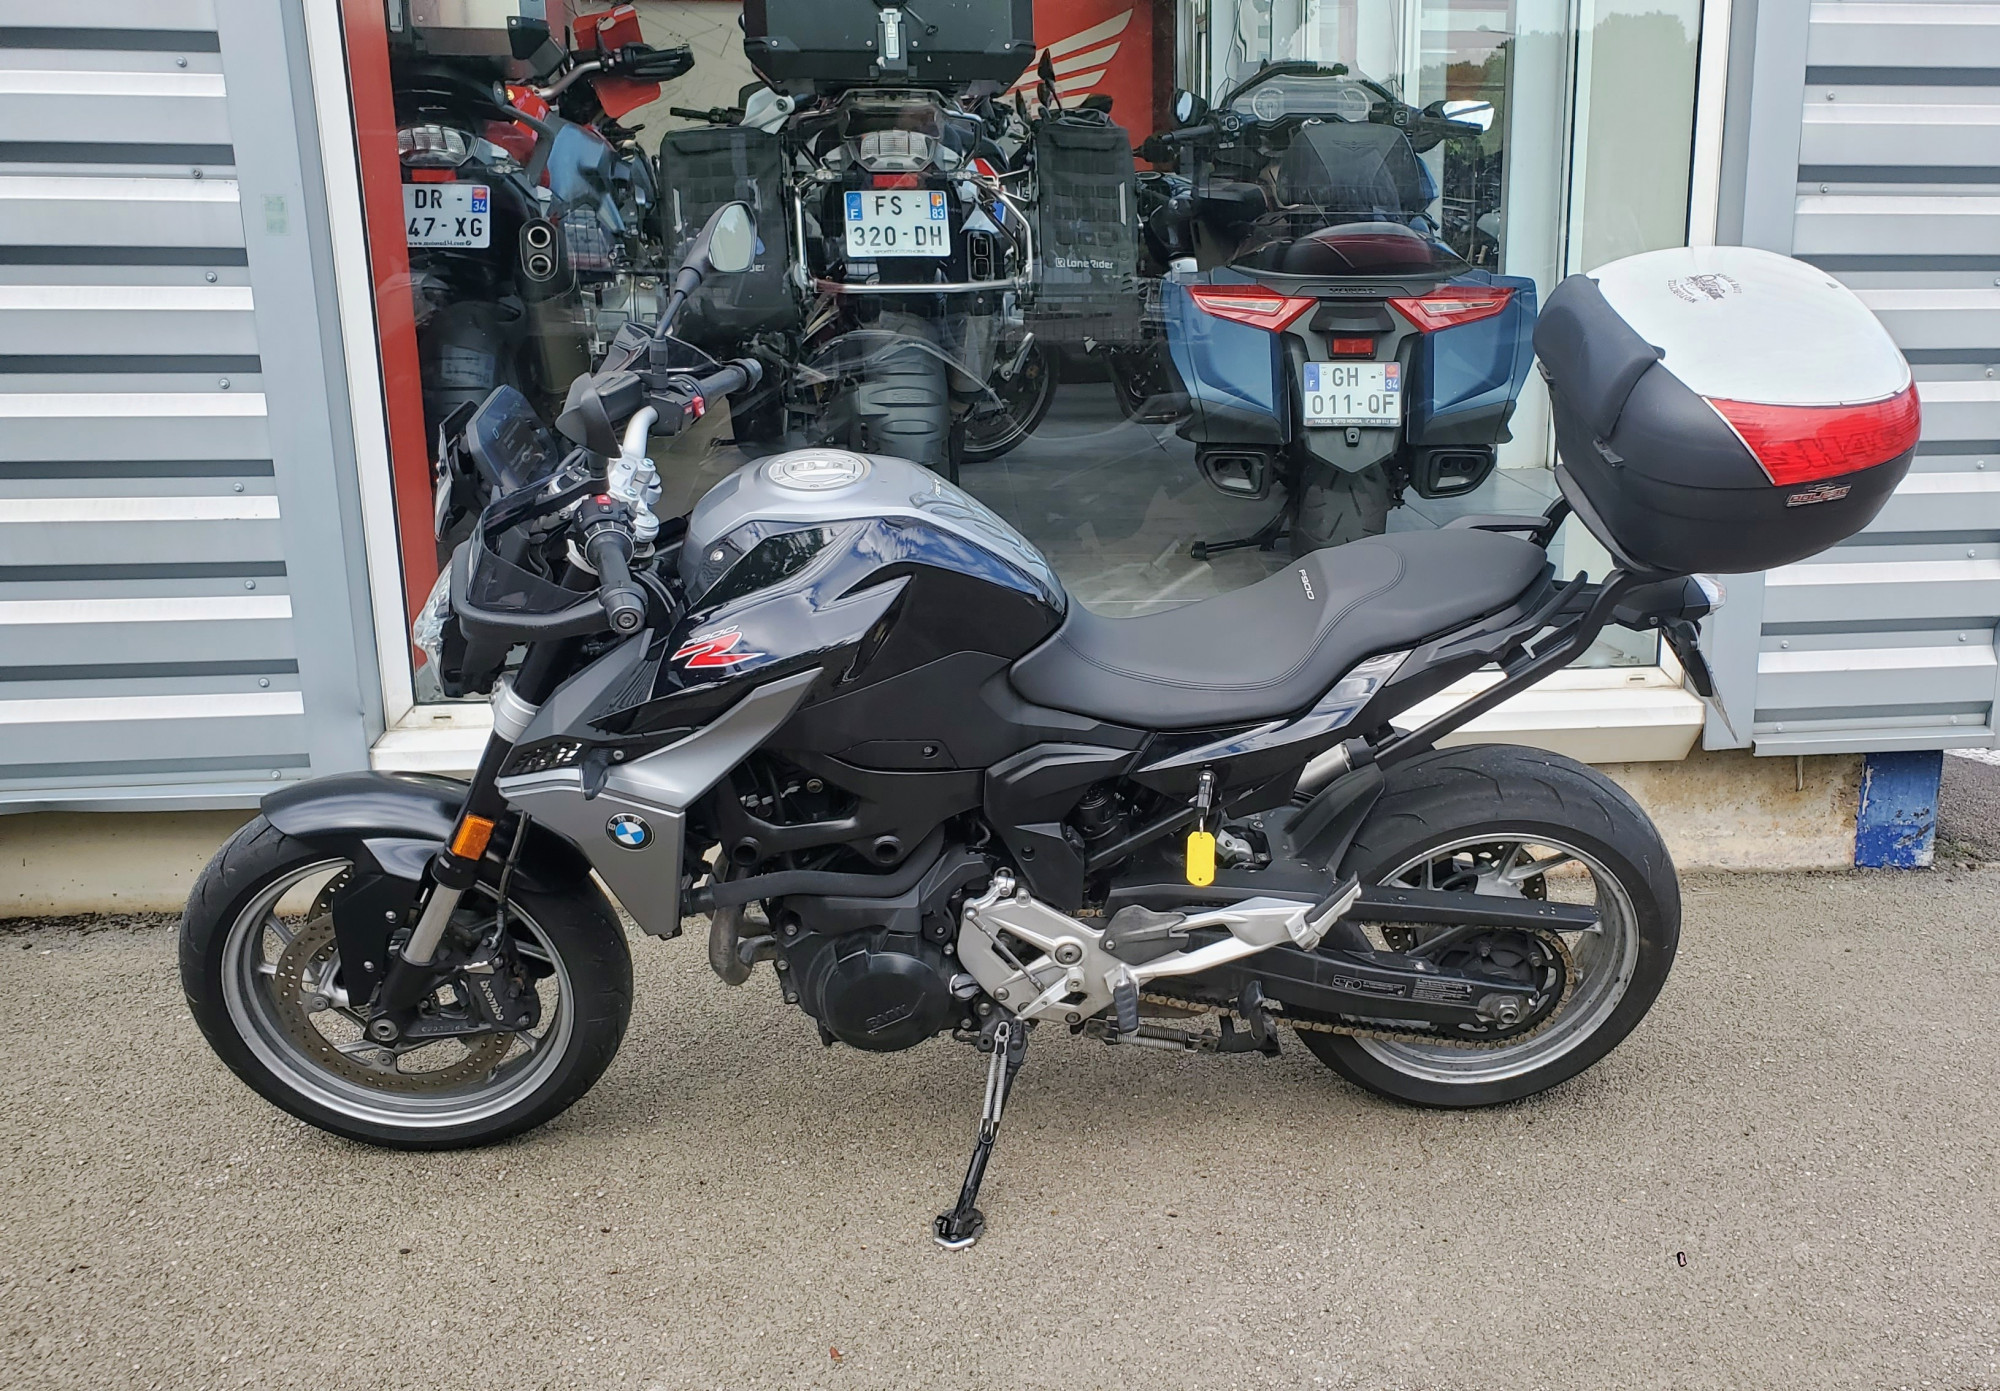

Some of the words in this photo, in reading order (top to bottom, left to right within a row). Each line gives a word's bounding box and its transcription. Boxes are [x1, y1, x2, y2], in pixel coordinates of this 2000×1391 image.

[414, 189, 443, 209] DR
[472, 200, 487, 212] 34
[875, 195, 903, 216] FS
[850, 209, 859, 219] F
[931, 208, 944, 219] 83
[853, 226, 943, 247] 320-DH
[1309, 380, 1316, 388] F
[1332, 367, 1359, 387] GH
[1385, 379, 1399, 390] 34
[1298, 568, 1315, 600] F900
[680, 624, 739, 649] F900
[479, 979, 504, 1021] brembo
